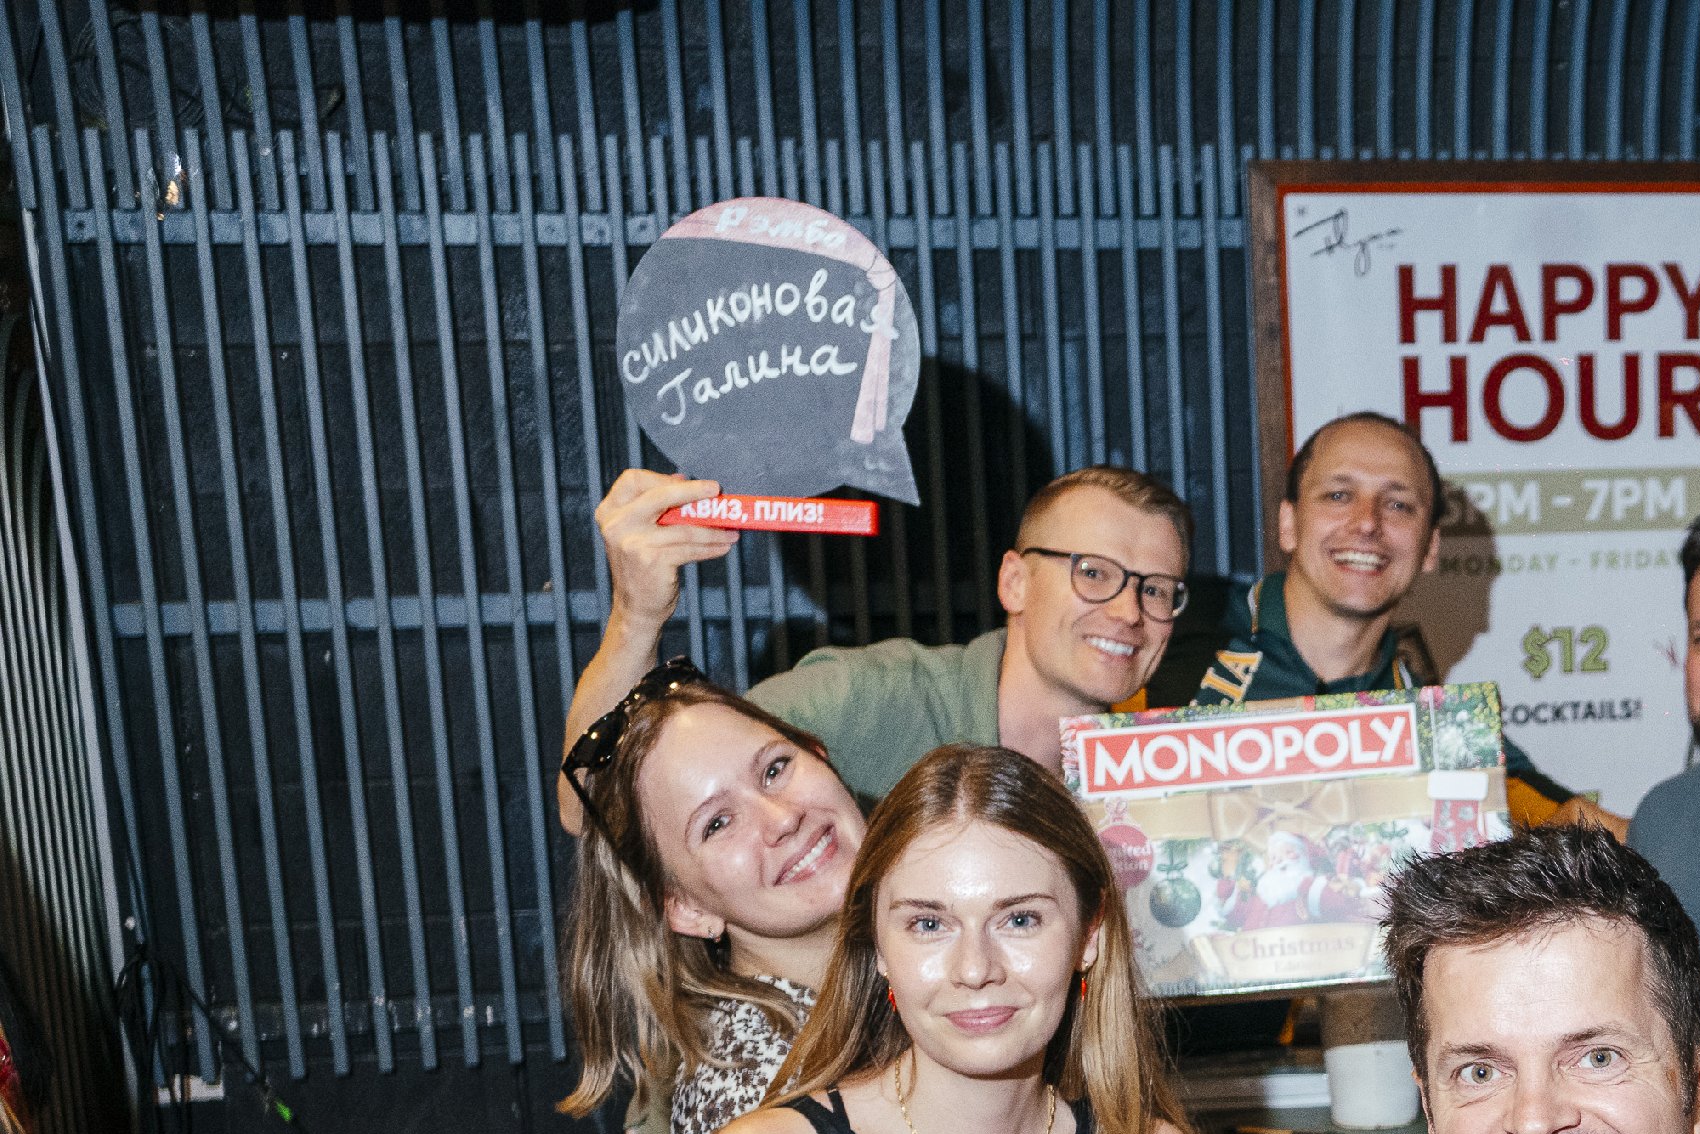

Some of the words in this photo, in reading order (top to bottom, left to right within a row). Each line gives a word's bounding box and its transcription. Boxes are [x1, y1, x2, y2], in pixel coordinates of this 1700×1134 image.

[657, 343, 857, 426] Галина
[754, 500, 825, 523] ПЛИЗ!
[1583, 476, 1687, 522] 7PM
[1522, 624, 1609, 680] $12
[1093, 714, 1406, 787] MONOPOLY
[1231, 935, 1354, 960] Christmas
